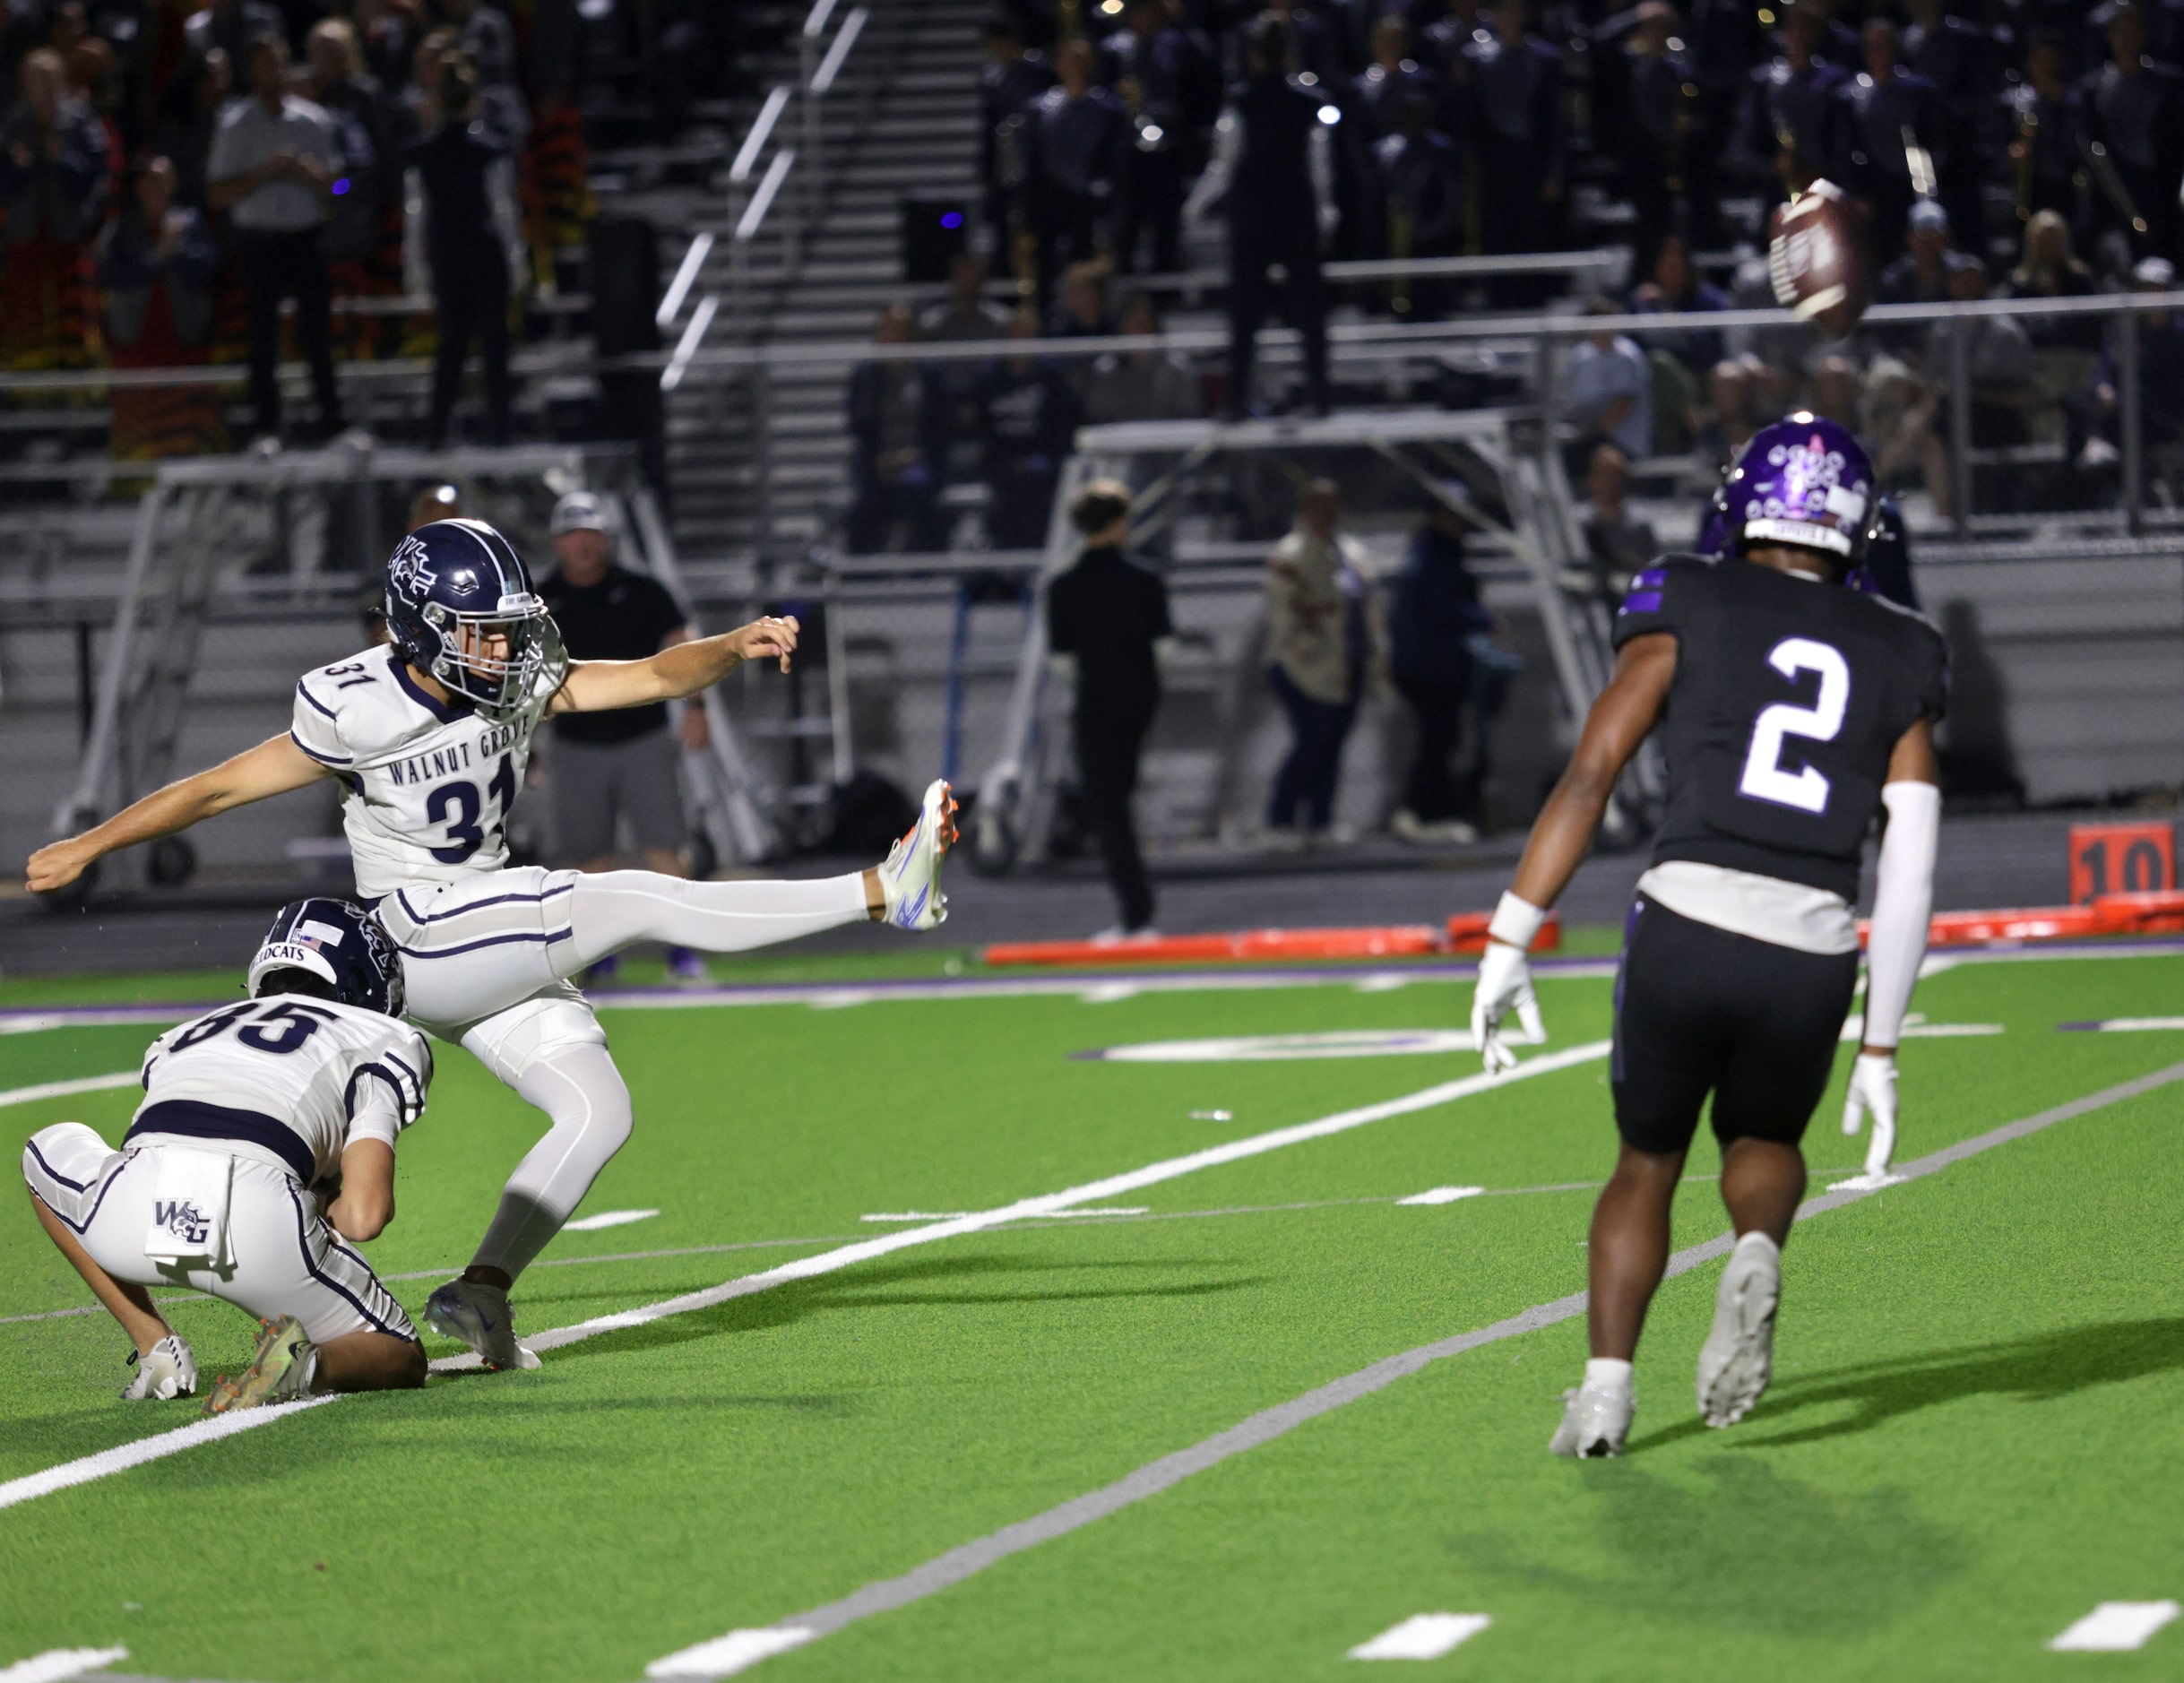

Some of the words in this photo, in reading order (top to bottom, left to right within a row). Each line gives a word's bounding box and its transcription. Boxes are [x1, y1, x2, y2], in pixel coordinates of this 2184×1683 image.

[324, 663, 376, 689] 31
[388, 742, 470, 786] WALNUT
[480, 715, 529, 758] GROVE
[1738, 637, 1849, 815] 2
[426, 751, 516, 864] 31
[2080, 838, 2162, 904] 10
